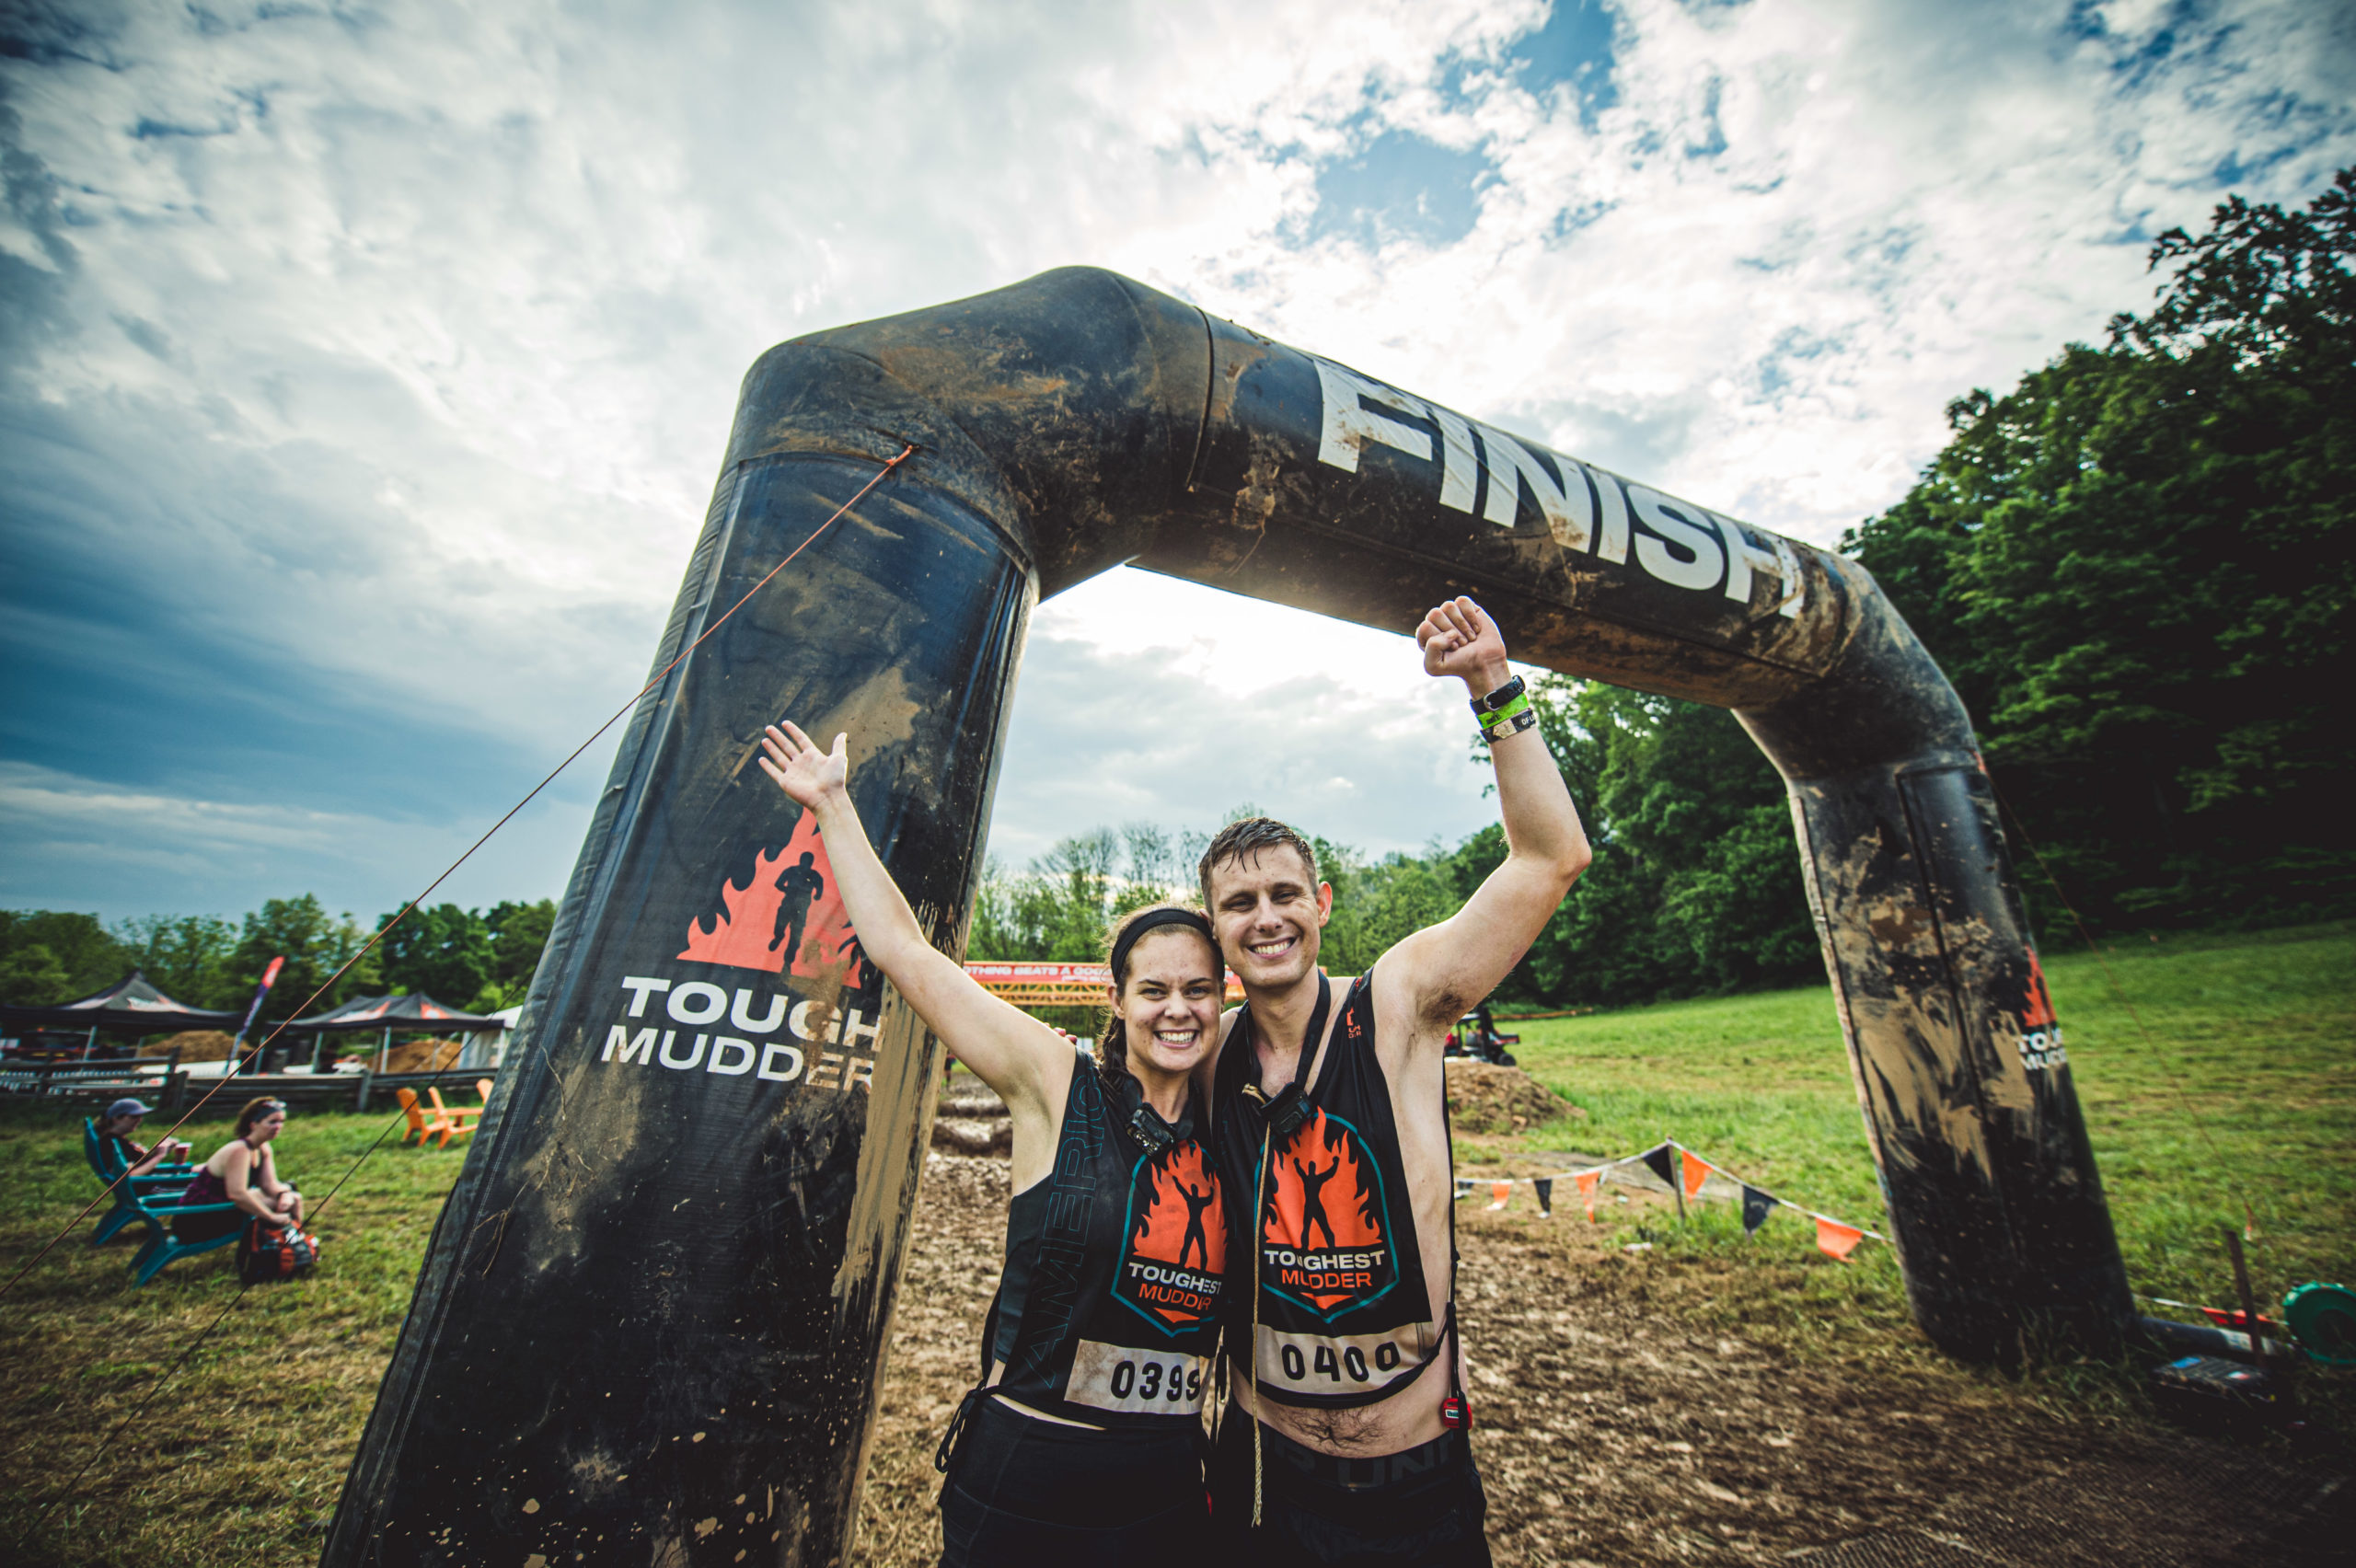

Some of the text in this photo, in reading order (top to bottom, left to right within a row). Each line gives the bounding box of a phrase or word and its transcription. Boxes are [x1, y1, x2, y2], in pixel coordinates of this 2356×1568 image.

[1313, 357, 1805, 619] FINISH
[963, 966, 1011, 975] OTHING
[1060, 966, 1071, 975] A
[621, 975, 888, 1053] TOUGH
[601, 1024, 874, 1092] MUDDER
[1024, 1067, 1106, 1389] AMERIC
[1111, 1360, 1201, 1402] 0399
[1281, 1341, 1401, 1382] 0400
